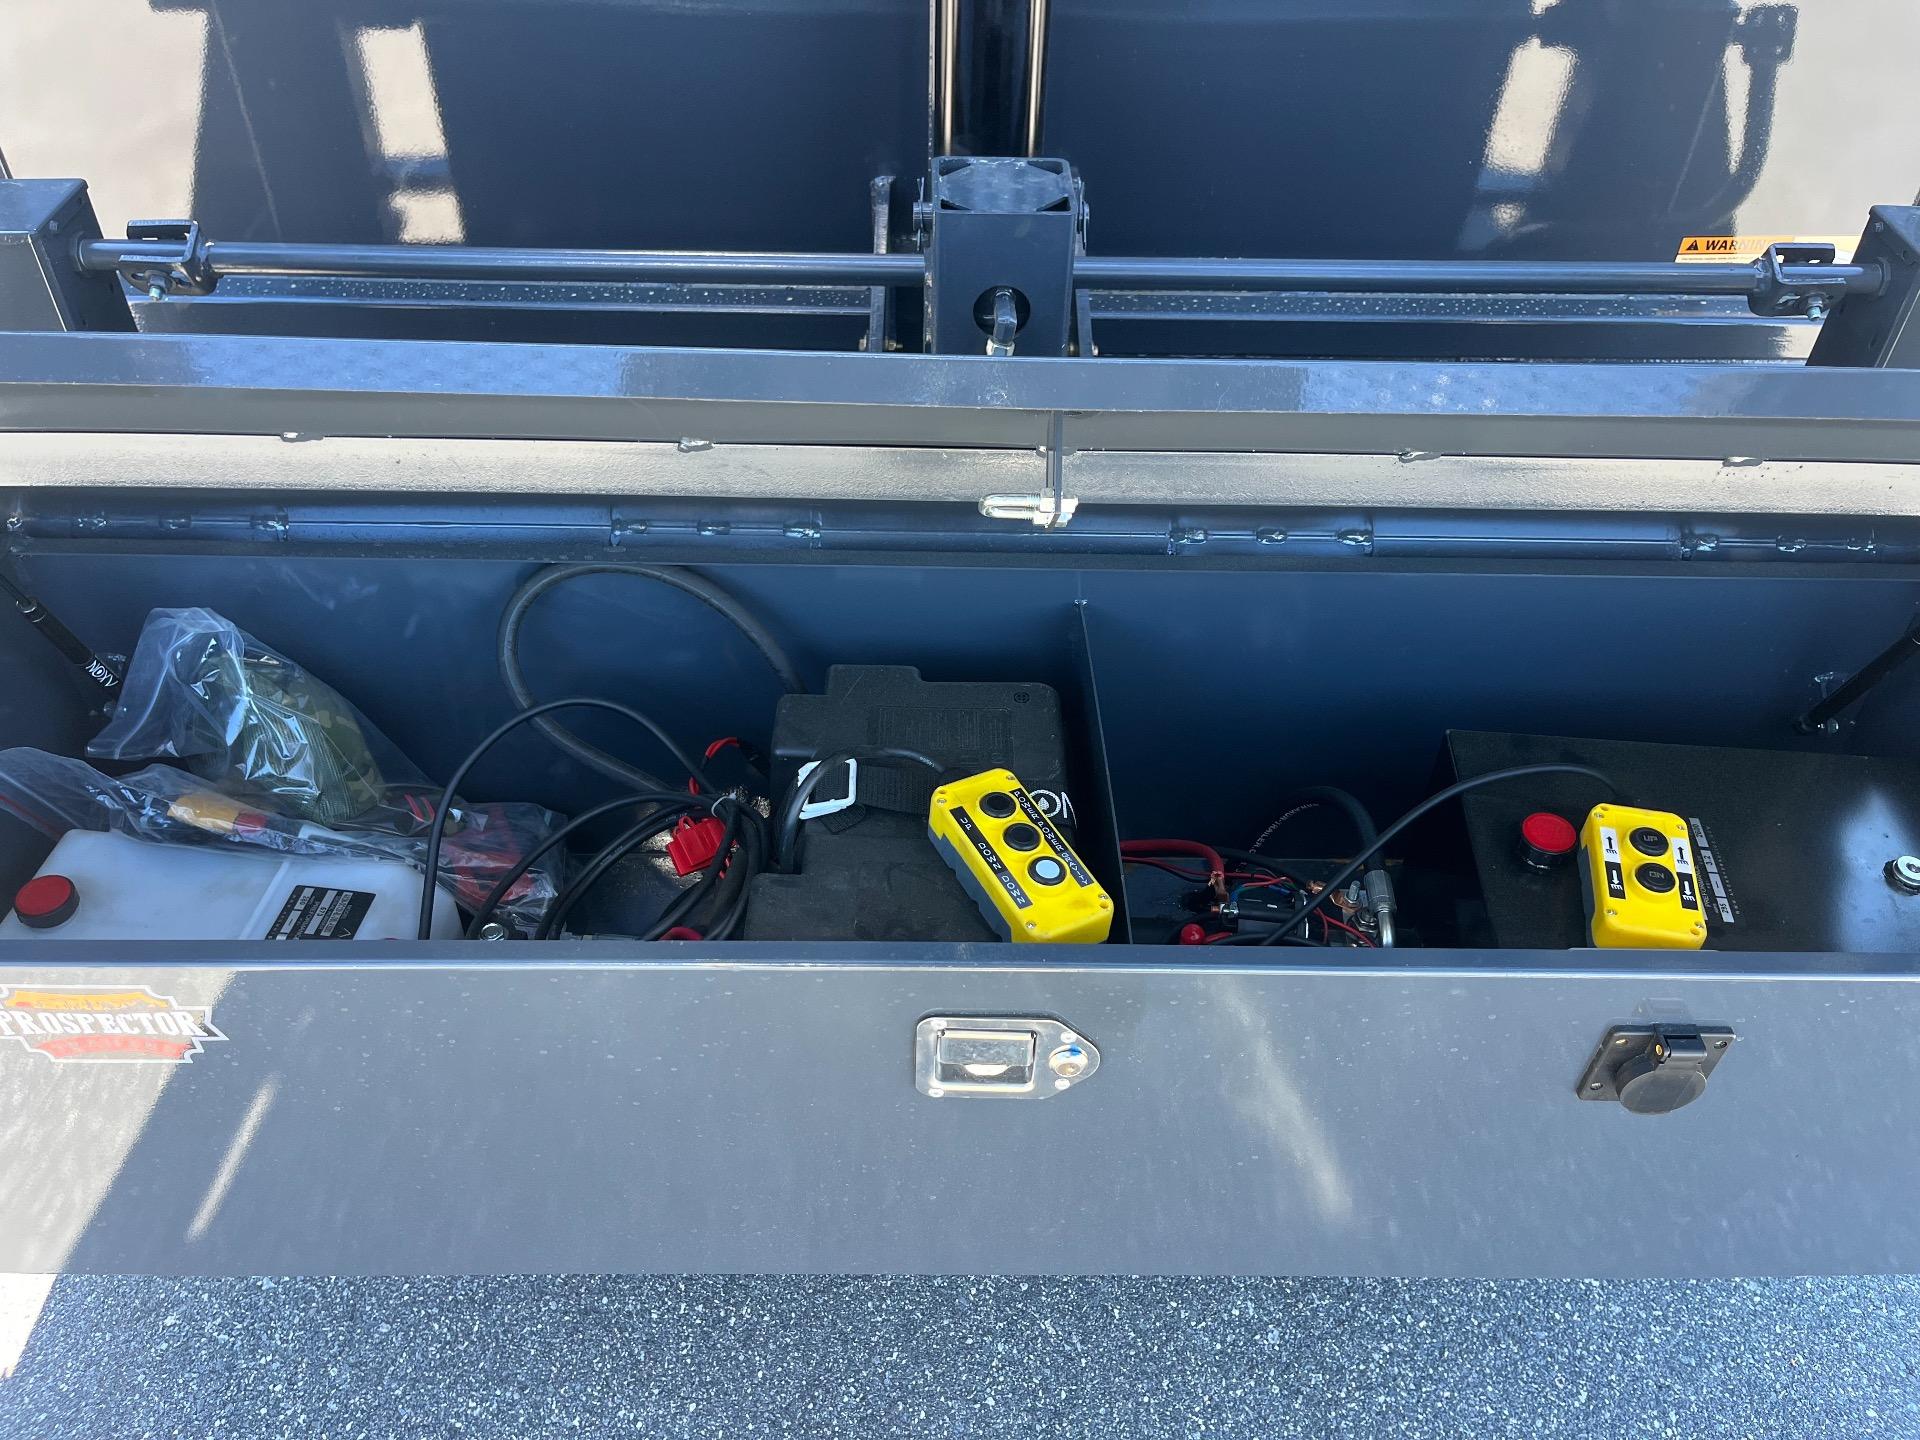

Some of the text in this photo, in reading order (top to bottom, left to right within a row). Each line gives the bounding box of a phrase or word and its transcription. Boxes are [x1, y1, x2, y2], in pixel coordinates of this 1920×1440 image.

[1705, 239, 1769, 251] WARNIN
[960, 817, 1026, 904] UP DOWN DOWN
[1014, 791, 1088, 885] POWER POWER GRAVITY
[0, 1010, 208, 1037] PROSPECTOR
